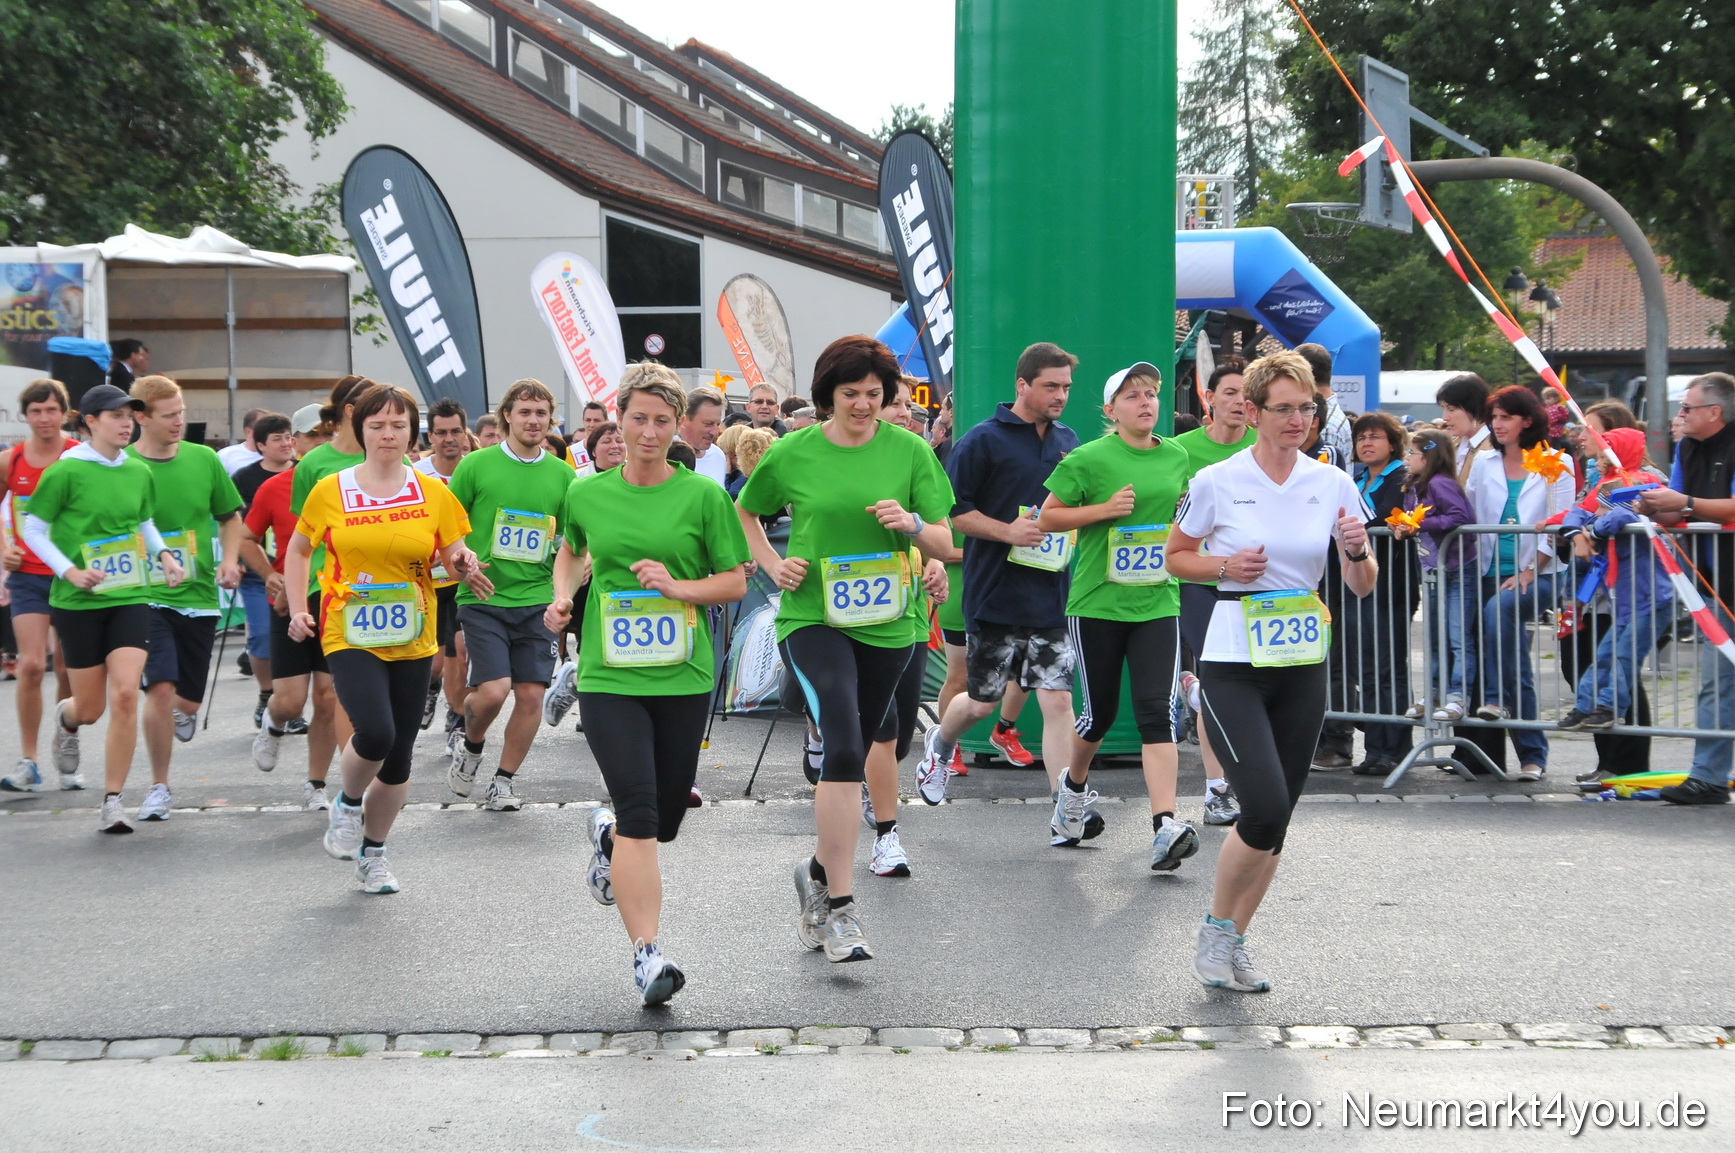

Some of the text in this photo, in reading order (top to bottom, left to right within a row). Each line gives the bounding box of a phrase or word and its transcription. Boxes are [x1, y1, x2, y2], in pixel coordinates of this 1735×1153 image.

[345, 508, 430, 528] MAX BÖGL
[499, 526, 540, 550] 816
[1031, 533, 1065, 557] 31
[1115, 545, 1164, 571] 825
[833, 577, 892, 610] 832
[352, 604, 407, 631] 408
[358, 631, 389, 639] Christine
[613, 616, 676, 648] 830
[1250, 616, 1319, 647] 1238
[615, 648, 654, 656] Alexandra
[1265, 648, 1296, 656] Cornelia
